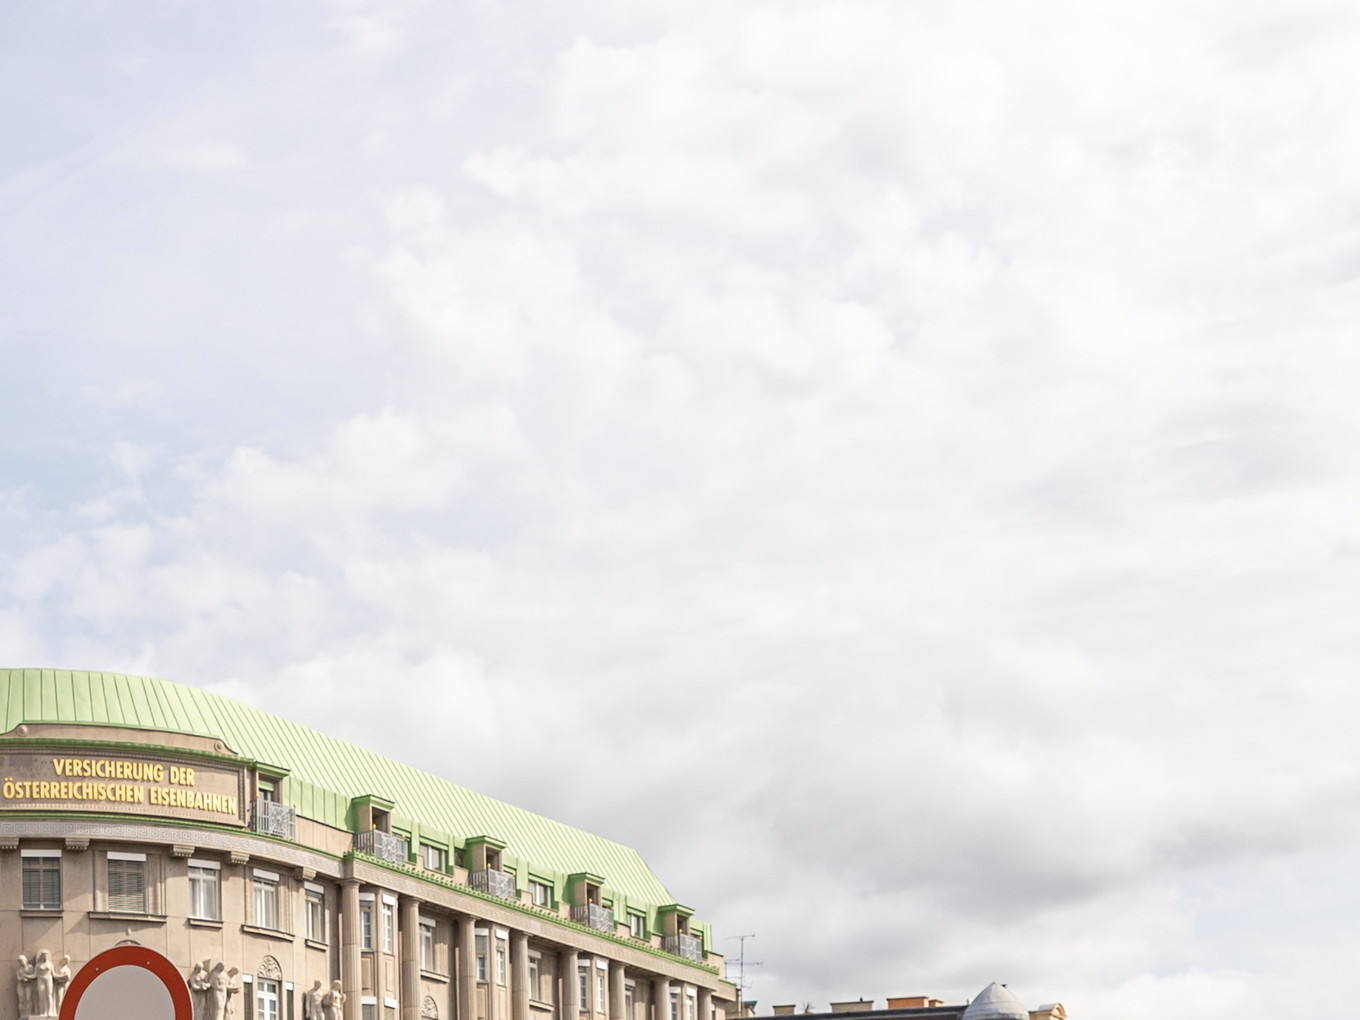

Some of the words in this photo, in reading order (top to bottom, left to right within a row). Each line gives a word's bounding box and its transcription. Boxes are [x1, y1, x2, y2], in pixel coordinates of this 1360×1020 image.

[53, 758, 164, 782] VERSICHERUNG
[169, 766, 196, 786] DER
[2, 777, 144, 803] ÖSTERREICHISCHEN
[150, 788, 237, 815] EISENBAHNEN
